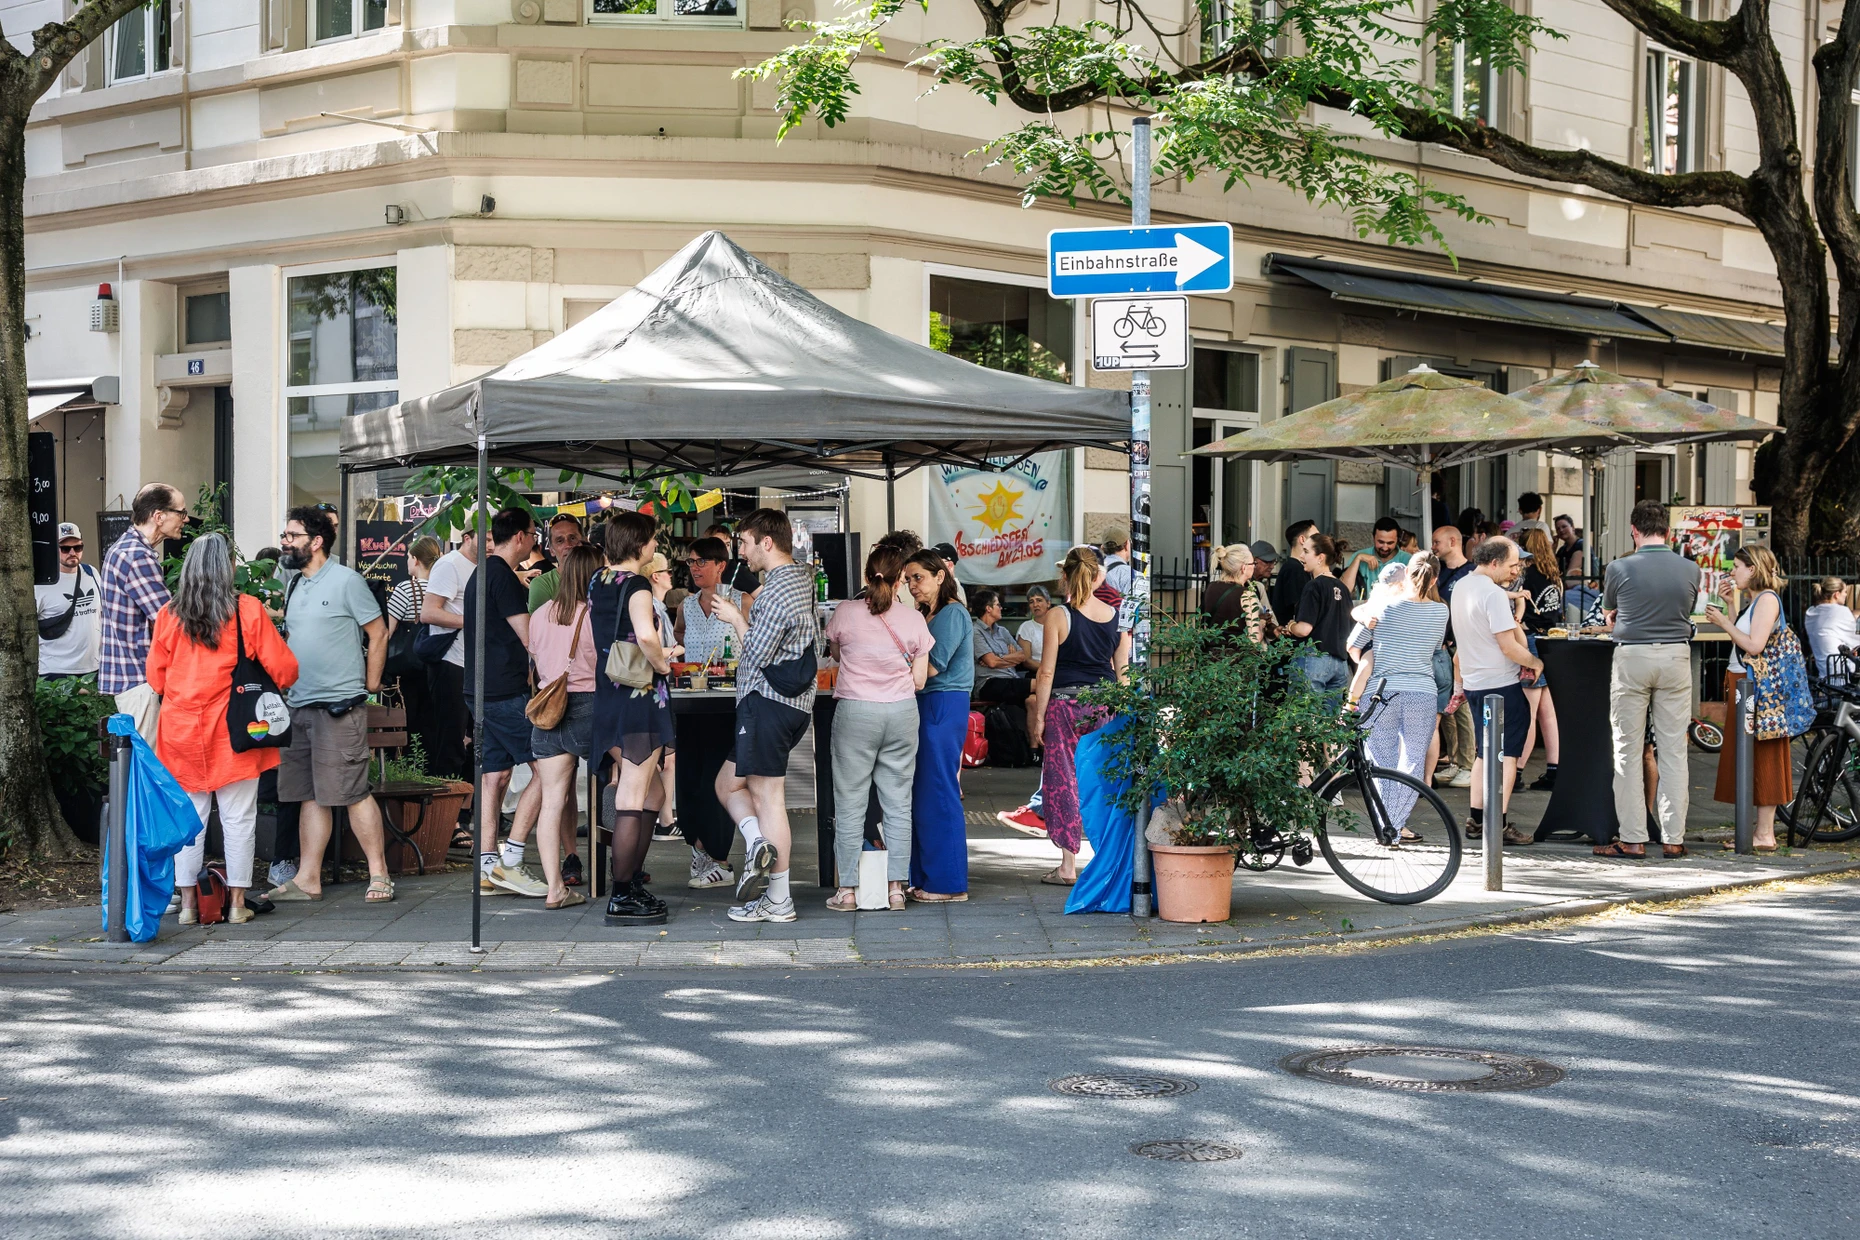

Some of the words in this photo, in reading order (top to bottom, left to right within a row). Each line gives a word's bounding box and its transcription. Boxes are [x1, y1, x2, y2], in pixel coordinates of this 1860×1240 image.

[1060, 252, 1178, 271] Einbahnstraße
[190, 361, 200, 373] 46
[33, 477, 50, 493] 3,00
[32, 511, 49, 525] 9,00
[954, 520, 1034, 558] ABSCHIEDSFEST
